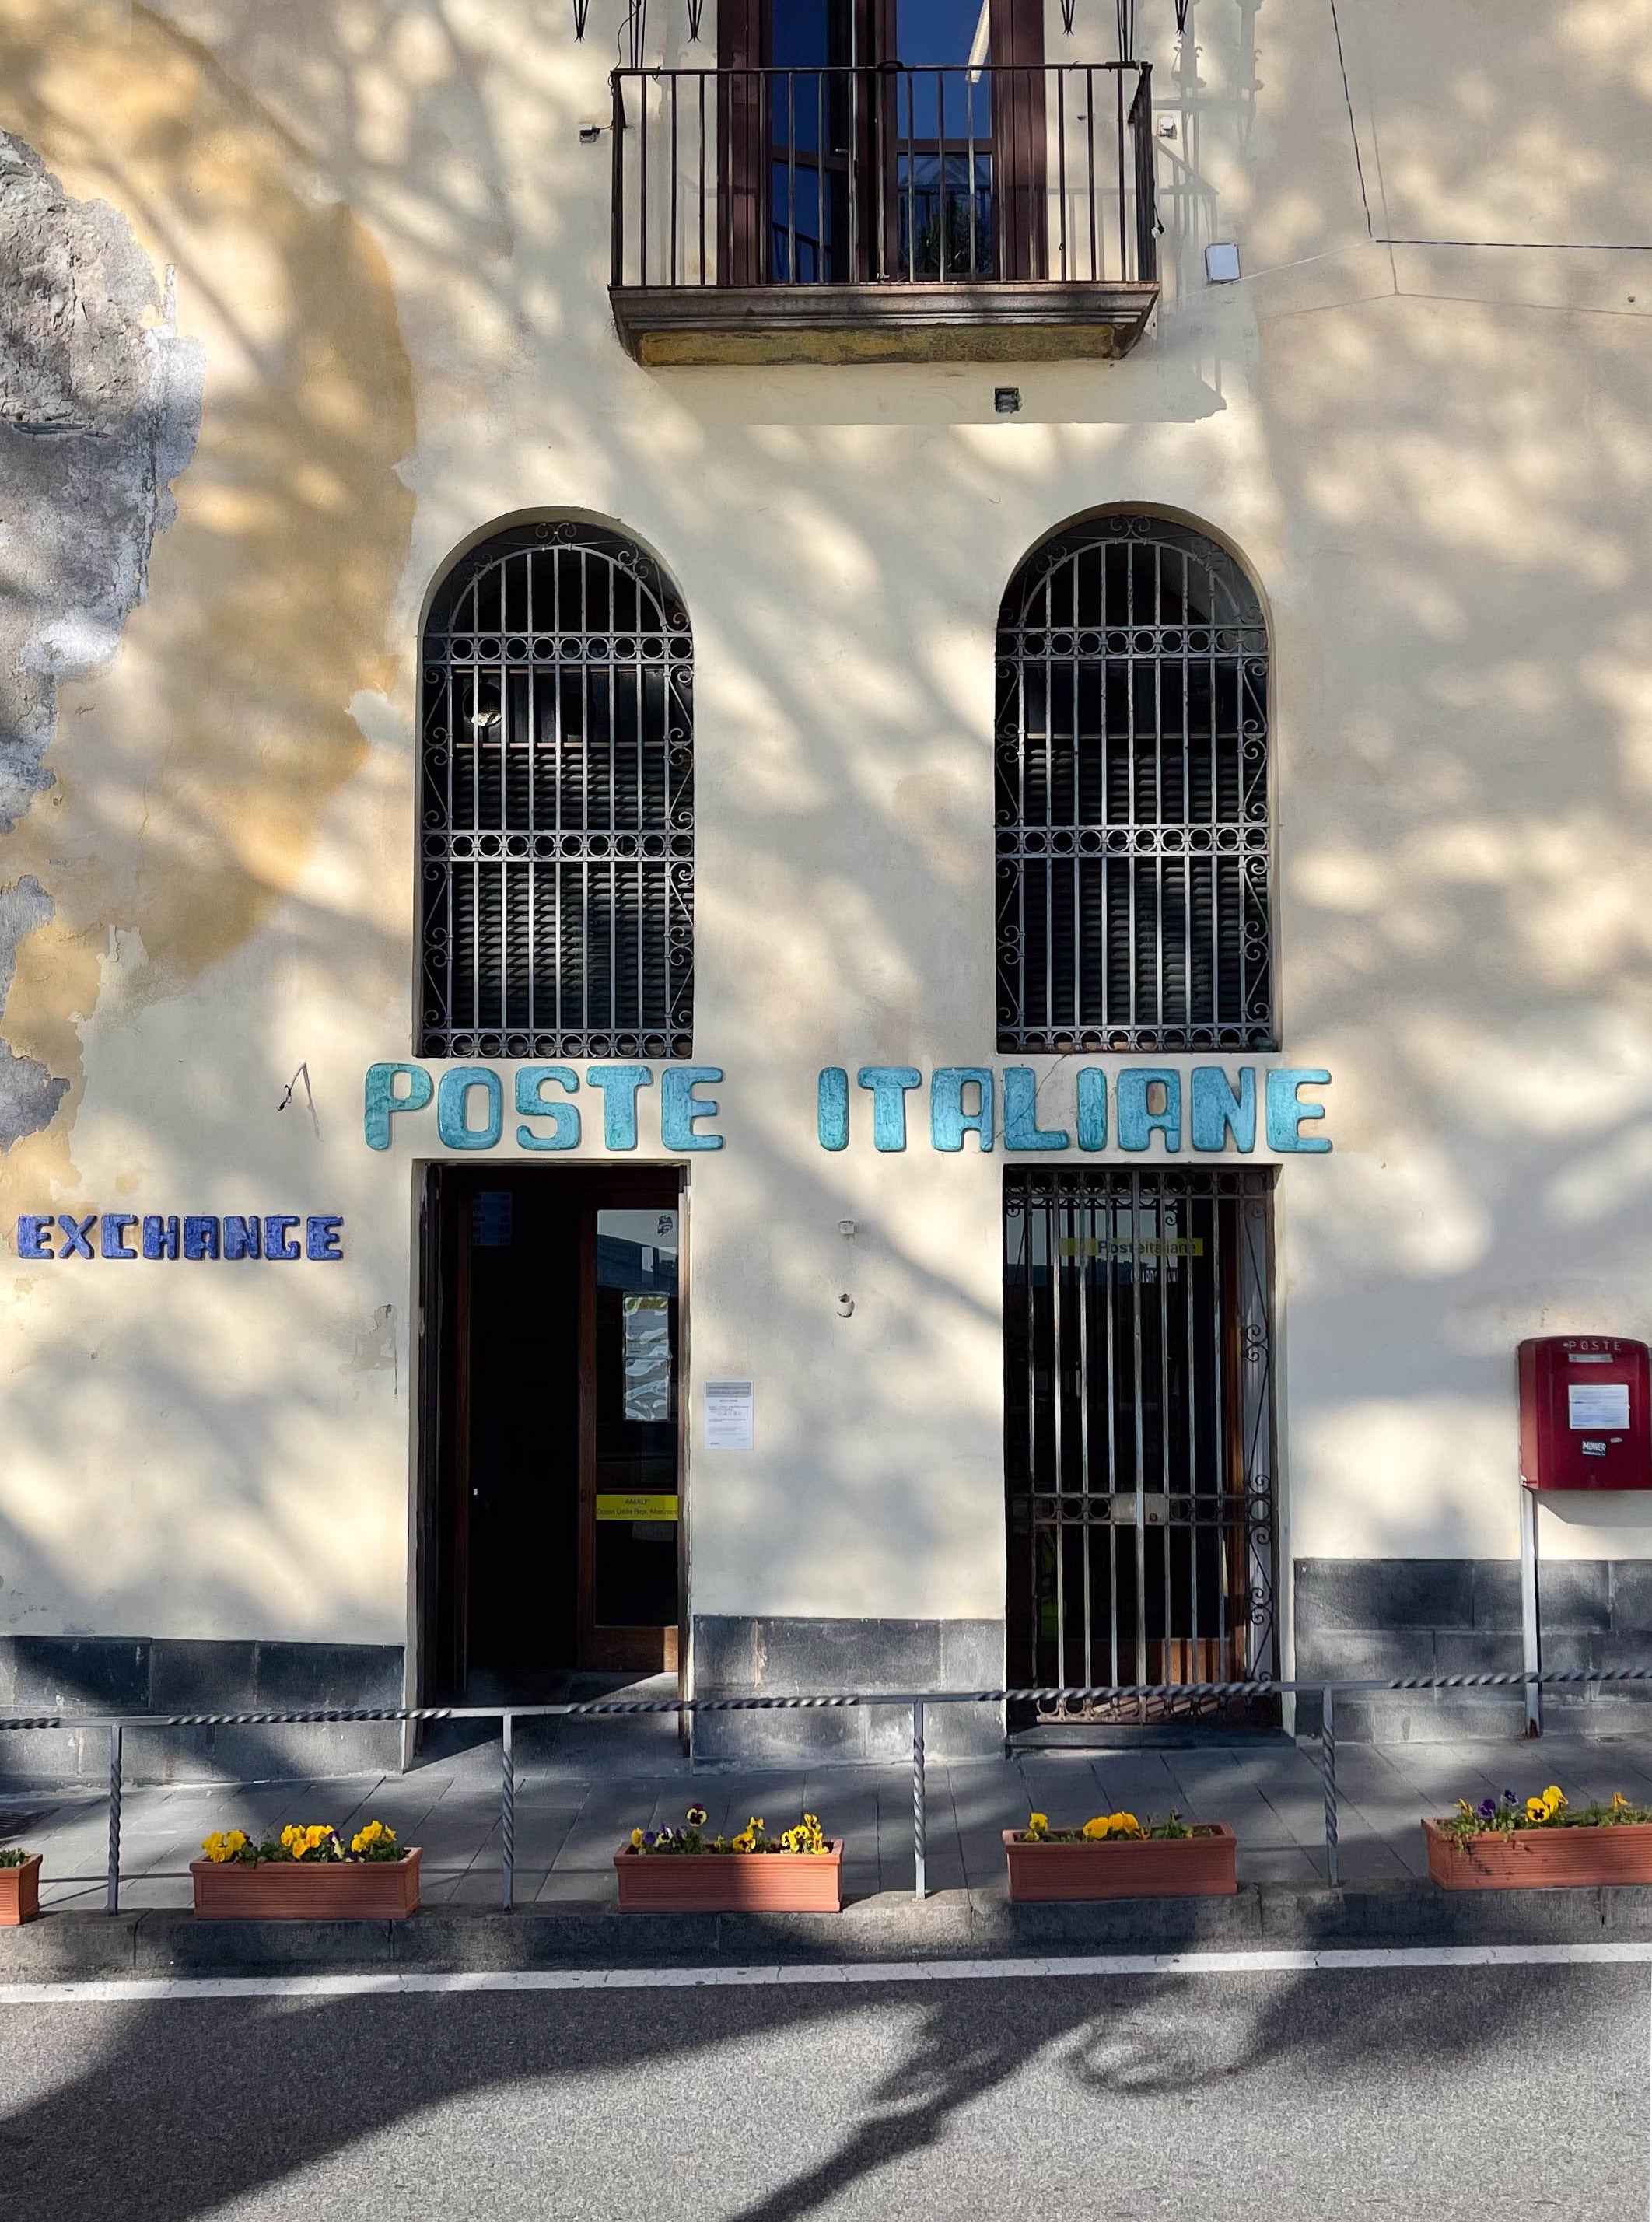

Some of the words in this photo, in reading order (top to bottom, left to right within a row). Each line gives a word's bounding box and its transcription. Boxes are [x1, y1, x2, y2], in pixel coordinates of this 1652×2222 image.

[364, 1063, 725, 1152] POSTE
[817, 1066, 1333, 1154] ITALIANE
[17, 1213, 344, 1261] EXCHANGE
[1097, 1239, 1196, 1254] Poseitaiane
[1569, 1341, 1622, 1351] POSTE
